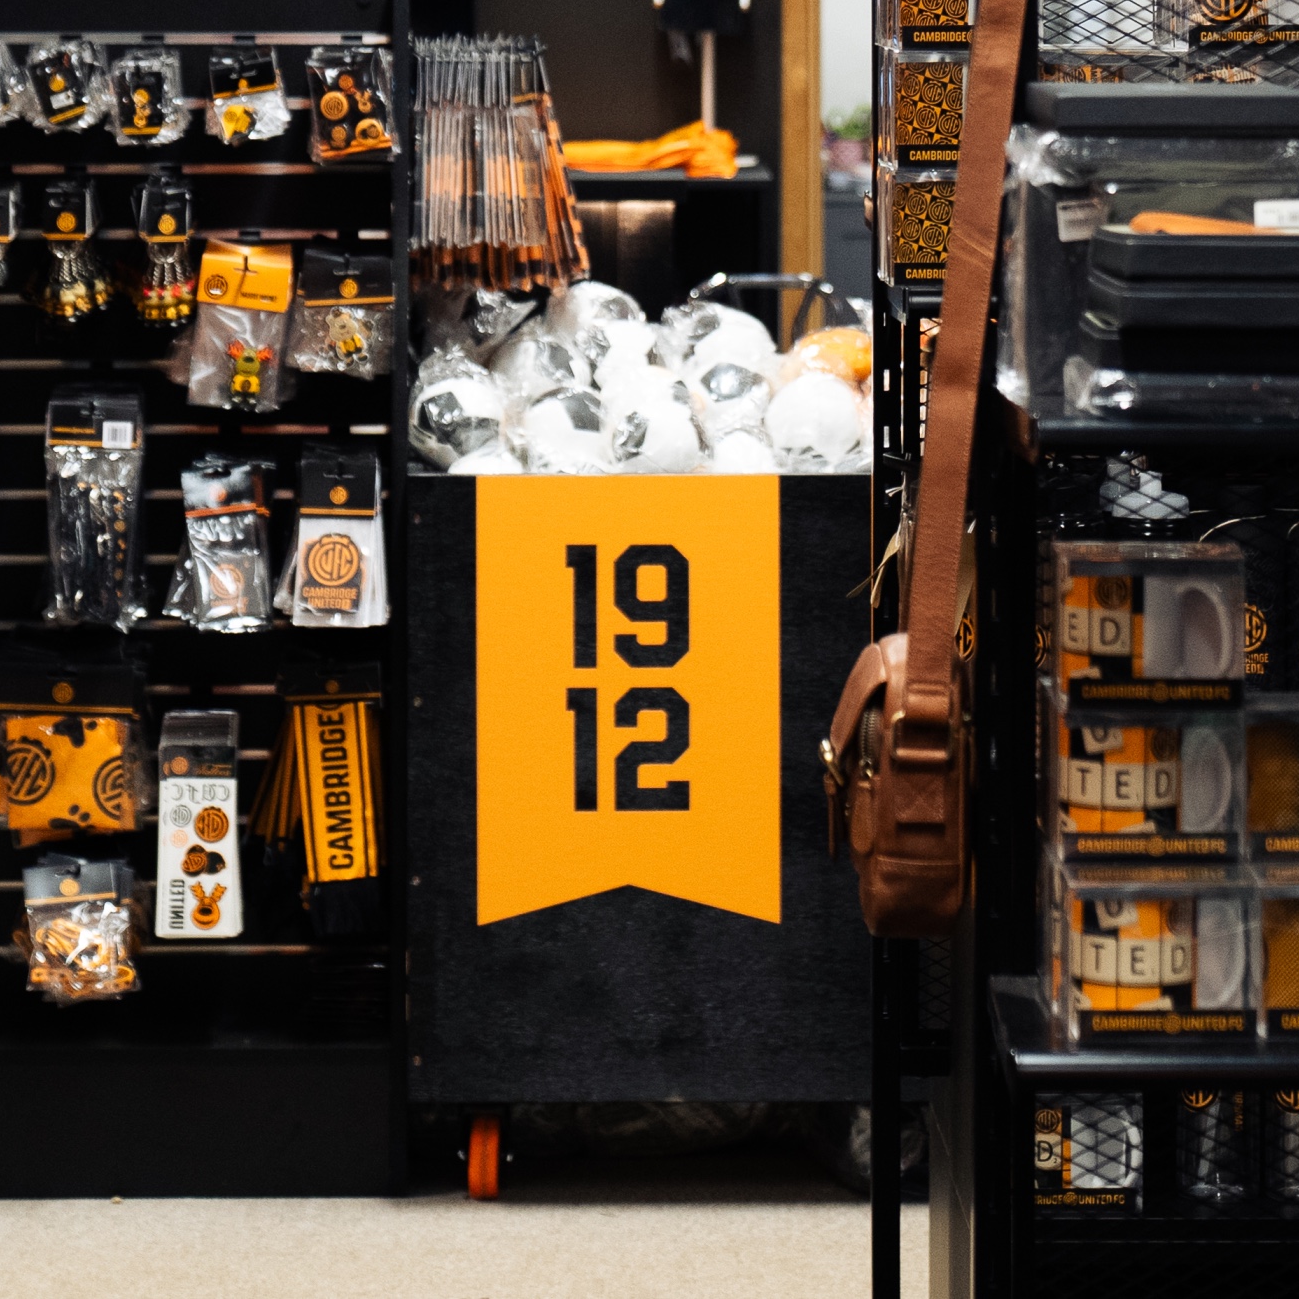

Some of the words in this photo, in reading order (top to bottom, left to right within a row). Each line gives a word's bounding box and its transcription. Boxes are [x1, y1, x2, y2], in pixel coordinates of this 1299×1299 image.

[913, 31, 967, 42] CAMBRIDGE
[905, 268, 947, 279] CAMBRID
[302, 587, 358, 599] CAMBRIDGE
[565, 544, 690, 669] 19
[565, 687, 691, 812] 12
[318, 708, 355, 871] CAMBRIDGE
[1076, 768, 1171, 800] TED
[1089, 942, 1188, 976] TED
